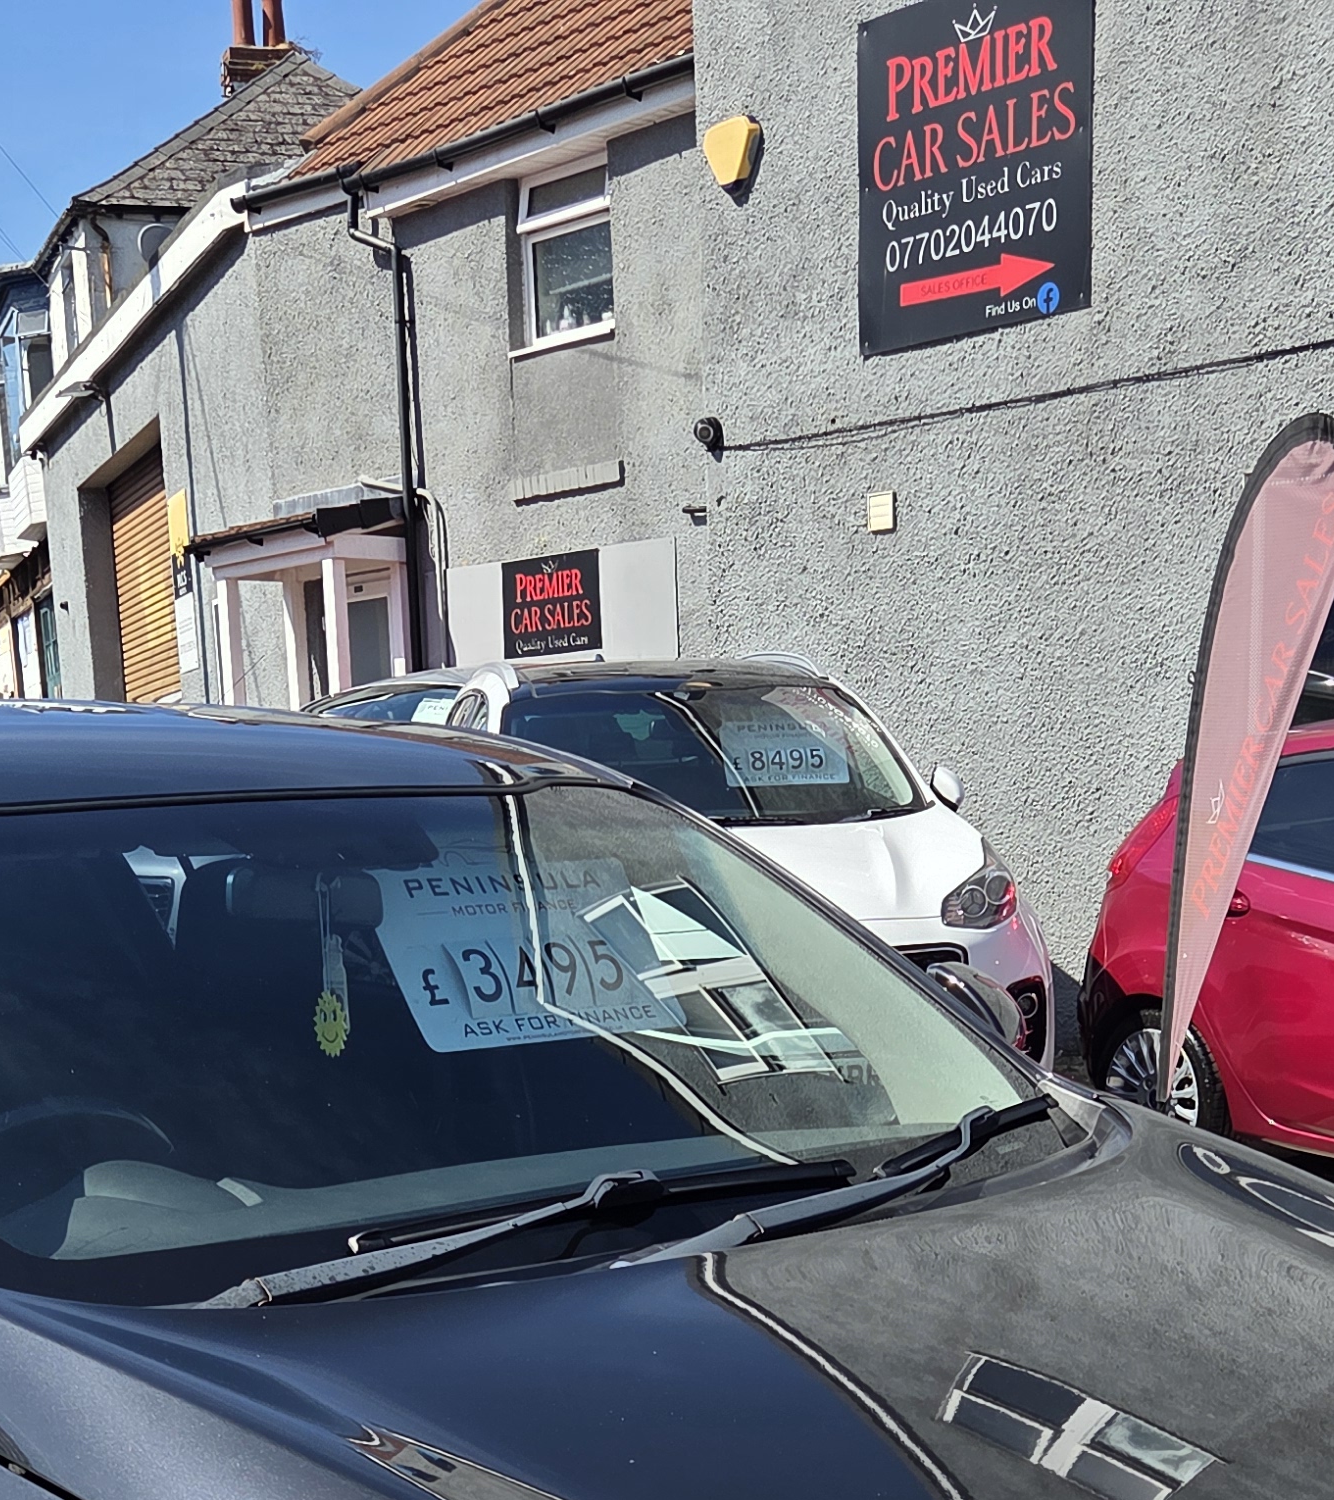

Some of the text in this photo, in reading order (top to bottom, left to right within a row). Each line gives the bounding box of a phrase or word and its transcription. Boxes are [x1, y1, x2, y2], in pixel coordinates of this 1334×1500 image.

[886, 15, 1058, 122] PREMIER
[873, 81, 1076, 191] CAR SALES
[882, 161, 1062, 230] Quality Used Cars
[886, 198, 1057, 273] 07702044070
[921, 274, 988, 297] SALES OFFICE
[985, 304, 1005, 318] Find
[1007, 301, 1020, 314] Us
[1022, 296, 1036, 310] On
[515, 568, 583, 603] PREMIER
[511, 599, 592, 634] CAR SALES
[515, 632, 589, 655] Quality Used Cars
[1192, 736, 1265, 921] PREMIER
[1255, 642, 1294, 732] CAR
[452, 899, 578, 918] MOTOR FIANCE
[463, 1019, 509, 1038] ASK
[517, 1014, 558, 1033] FOR
